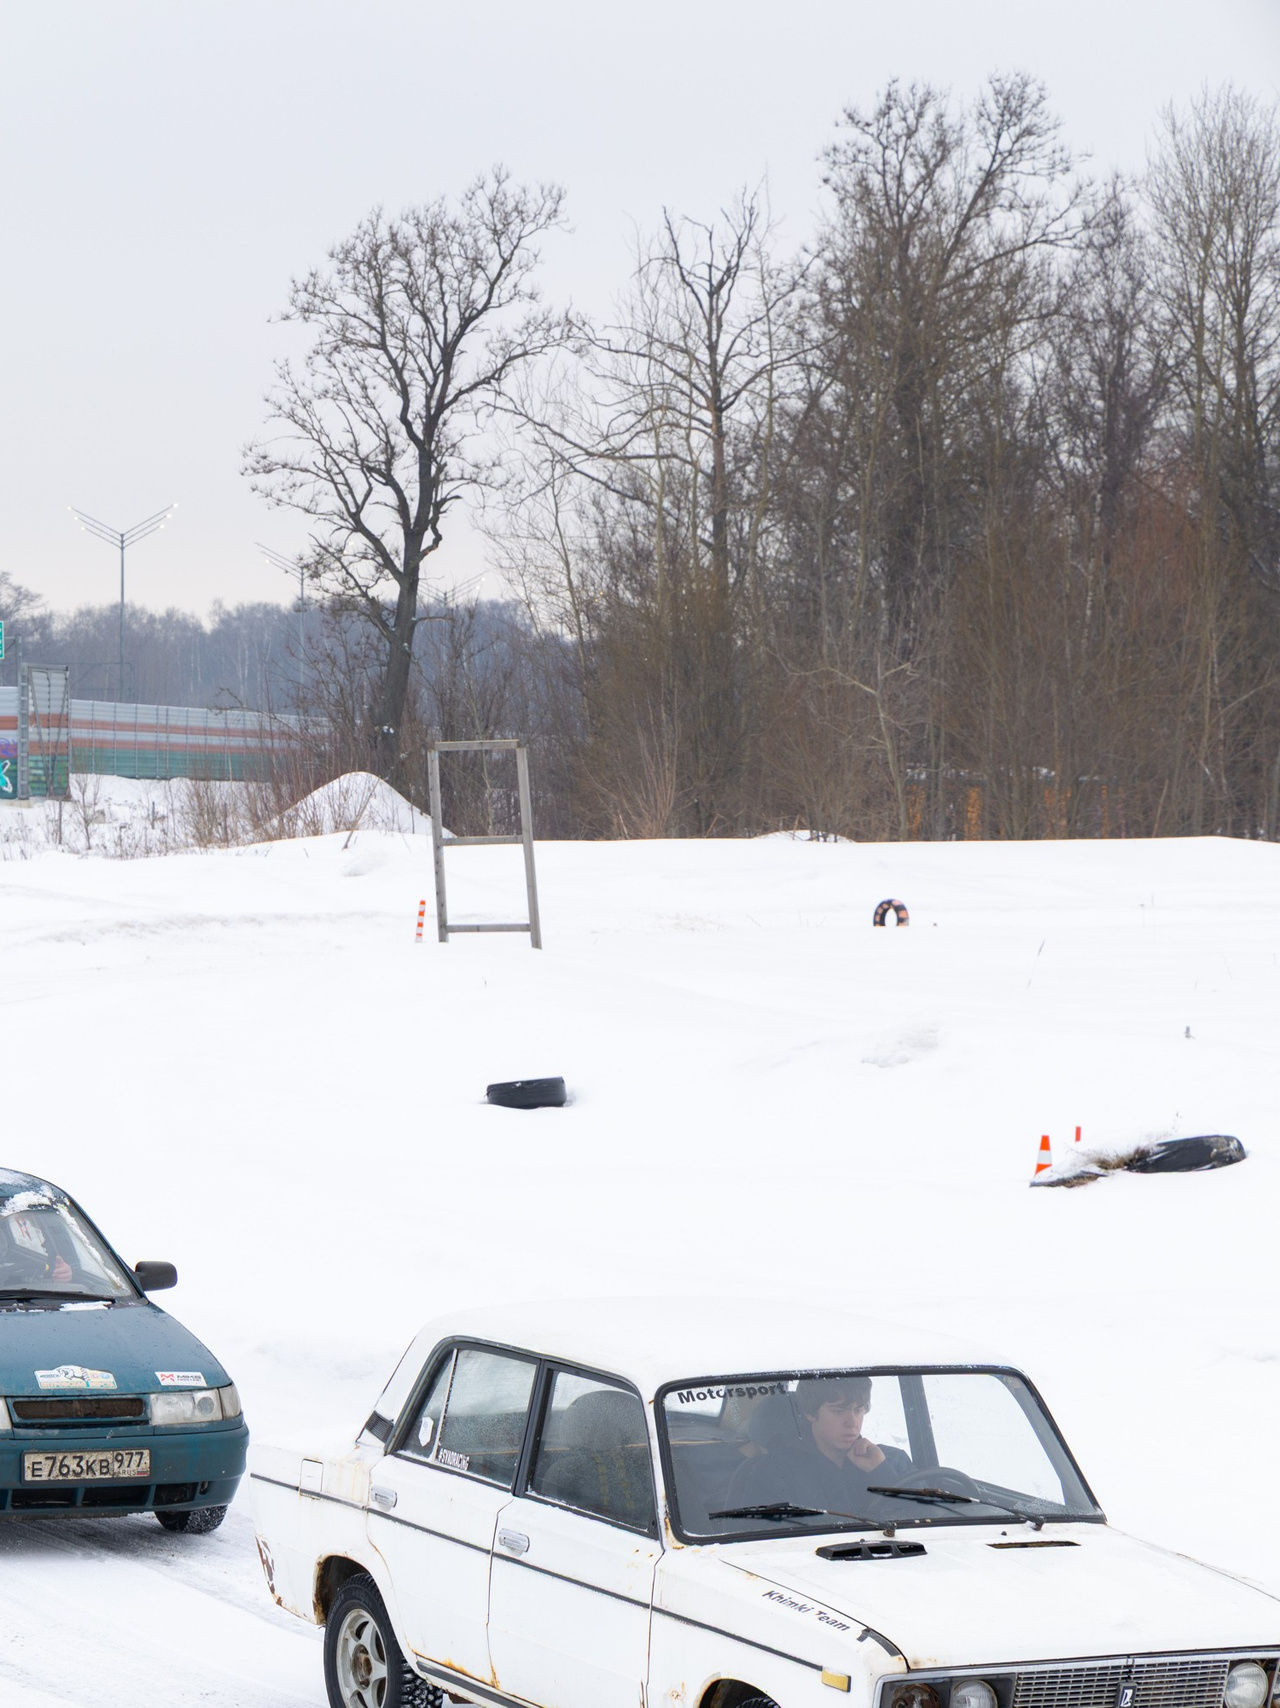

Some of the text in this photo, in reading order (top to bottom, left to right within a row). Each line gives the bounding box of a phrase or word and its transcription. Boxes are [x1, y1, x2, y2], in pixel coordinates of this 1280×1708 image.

[677, 1382, 787, 1404] Motorsport
[114, 1451, 144, 1469] 977
[762, 1590, 851, 1632] Khimki Team
